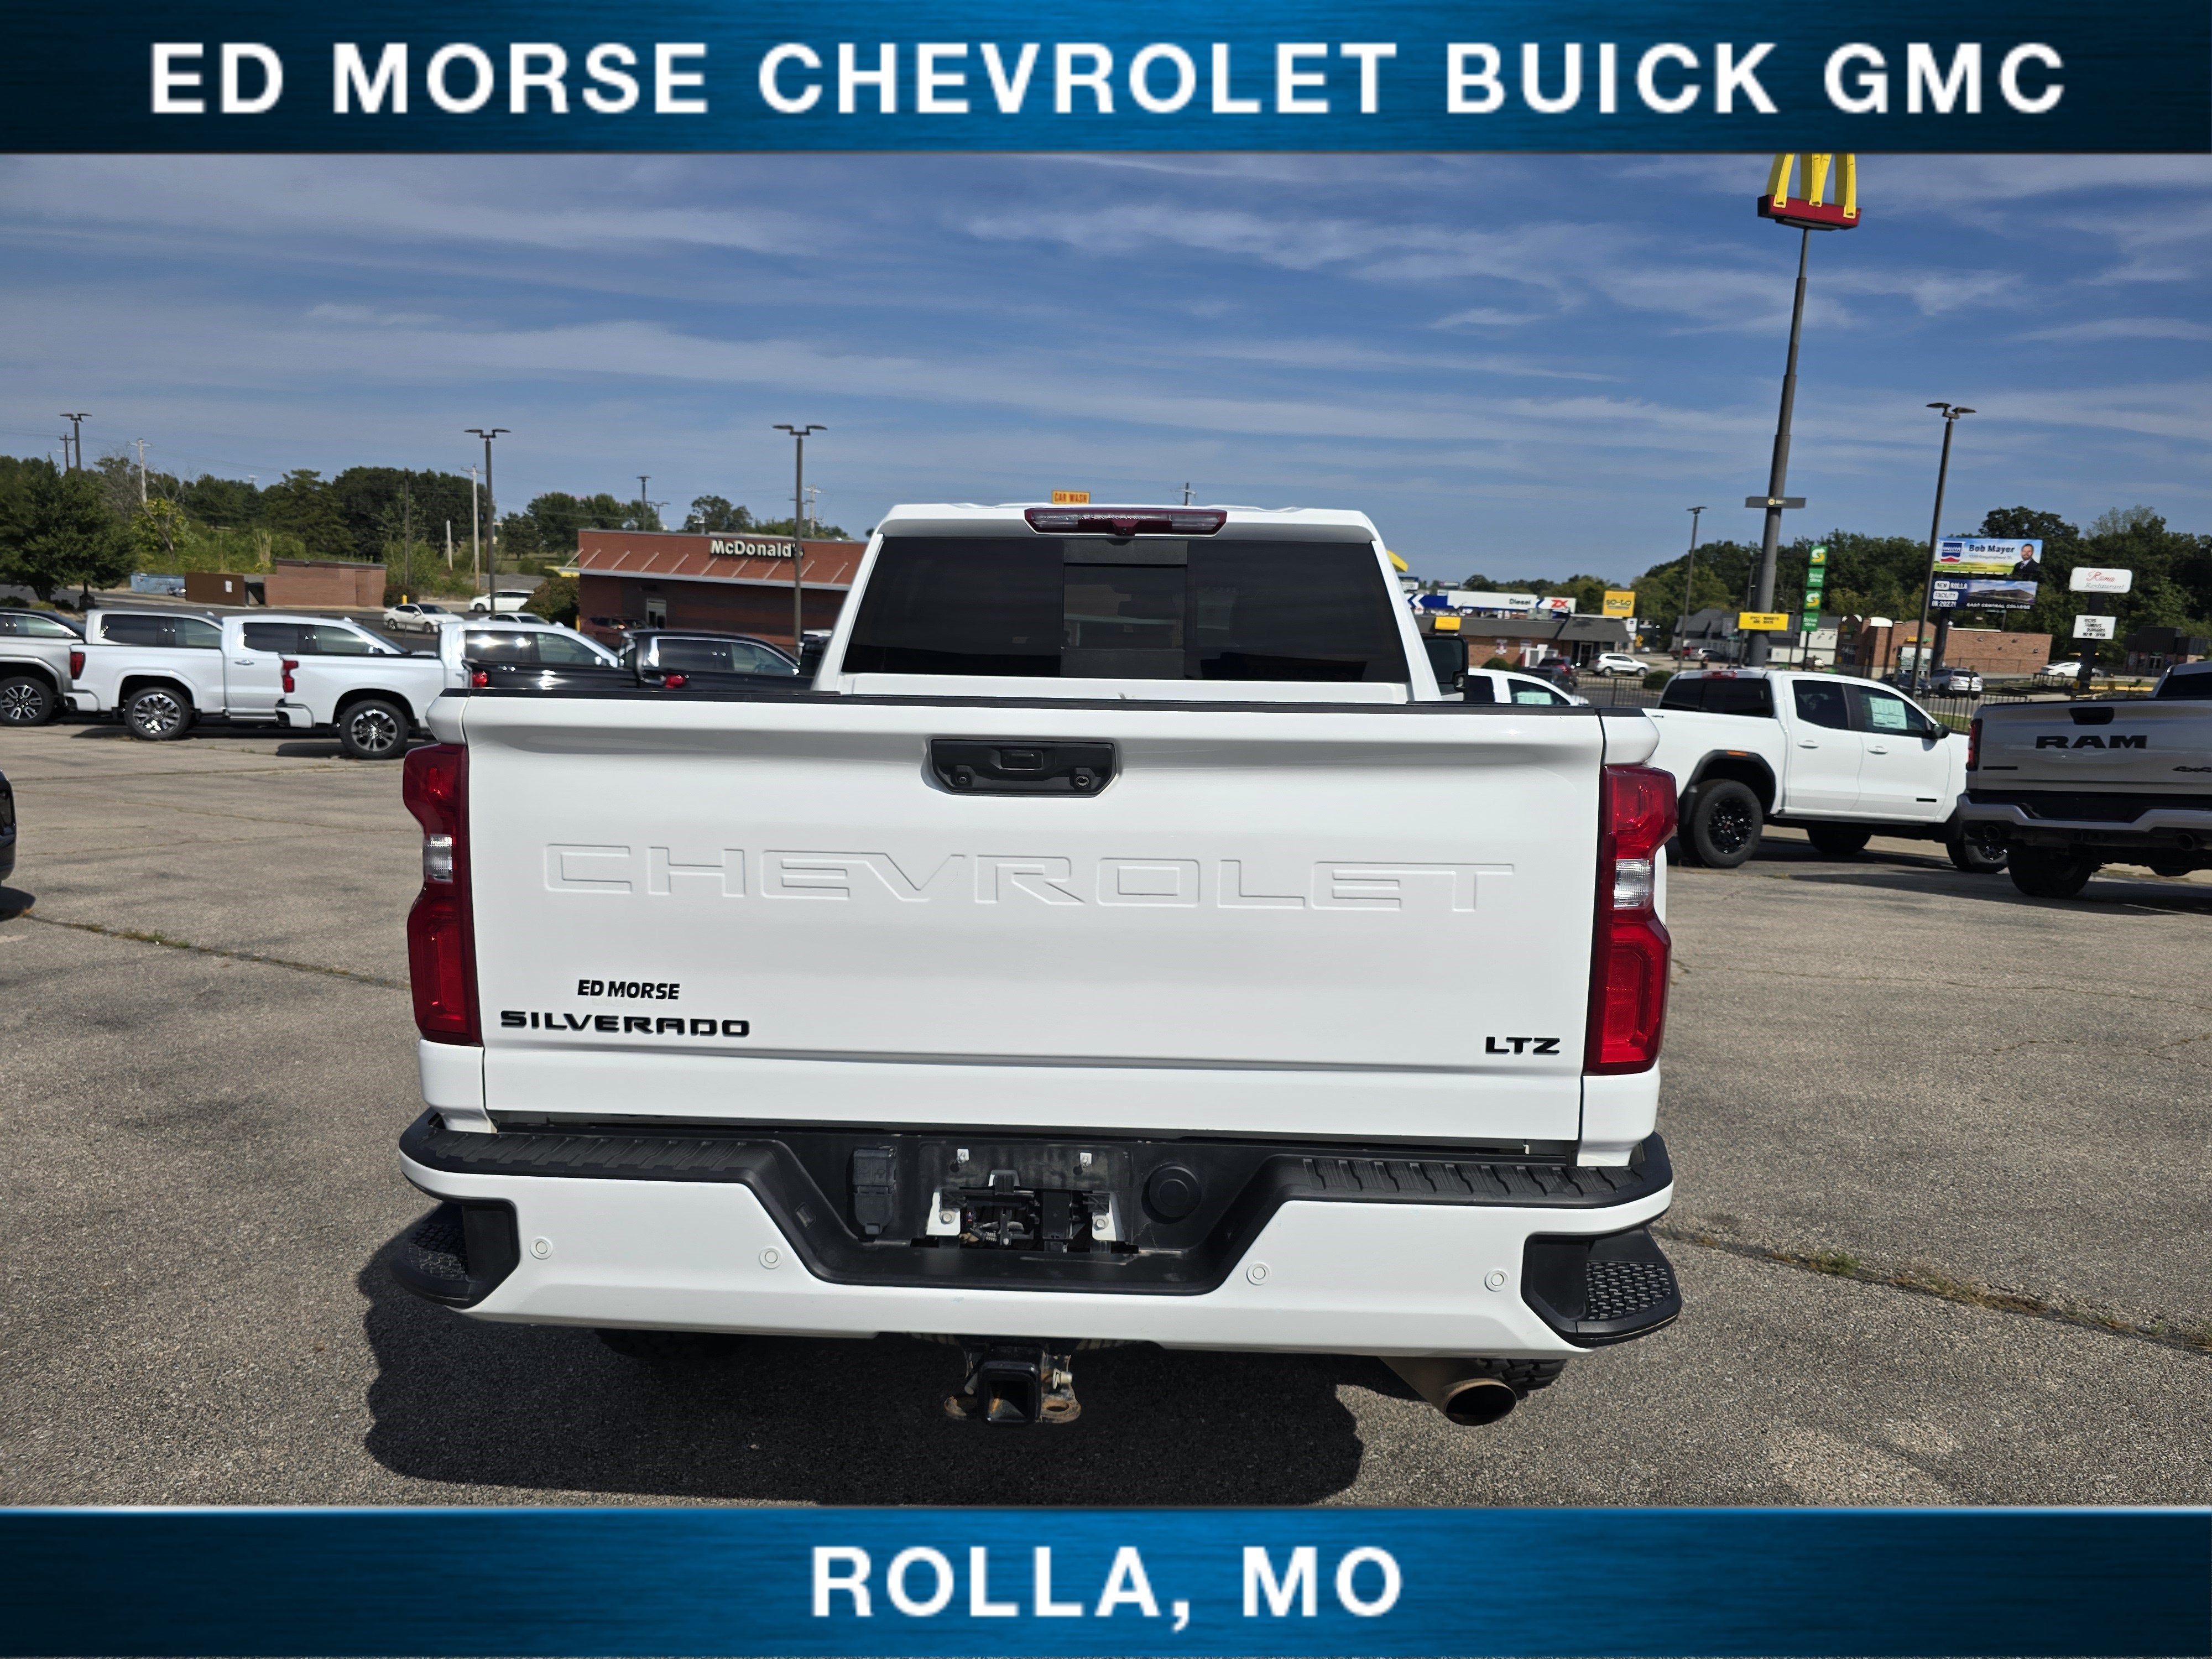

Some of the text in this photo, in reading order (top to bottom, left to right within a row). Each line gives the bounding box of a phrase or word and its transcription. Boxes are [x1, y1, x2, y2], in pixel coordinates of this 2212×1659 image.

[1054, 493, 1088, 503] CAR WASH
[1987, 545, 2015, 555] Mayer
[2036, 735, 2147, 749] RAM
[545, 843, 1515, 913] CHEVROLET
[577, 979, 681, 1000] ED MORSE
[499, 1010, 750, 1038] SILVERADO
[1485, 1036, 1561, 1056] LTZ
